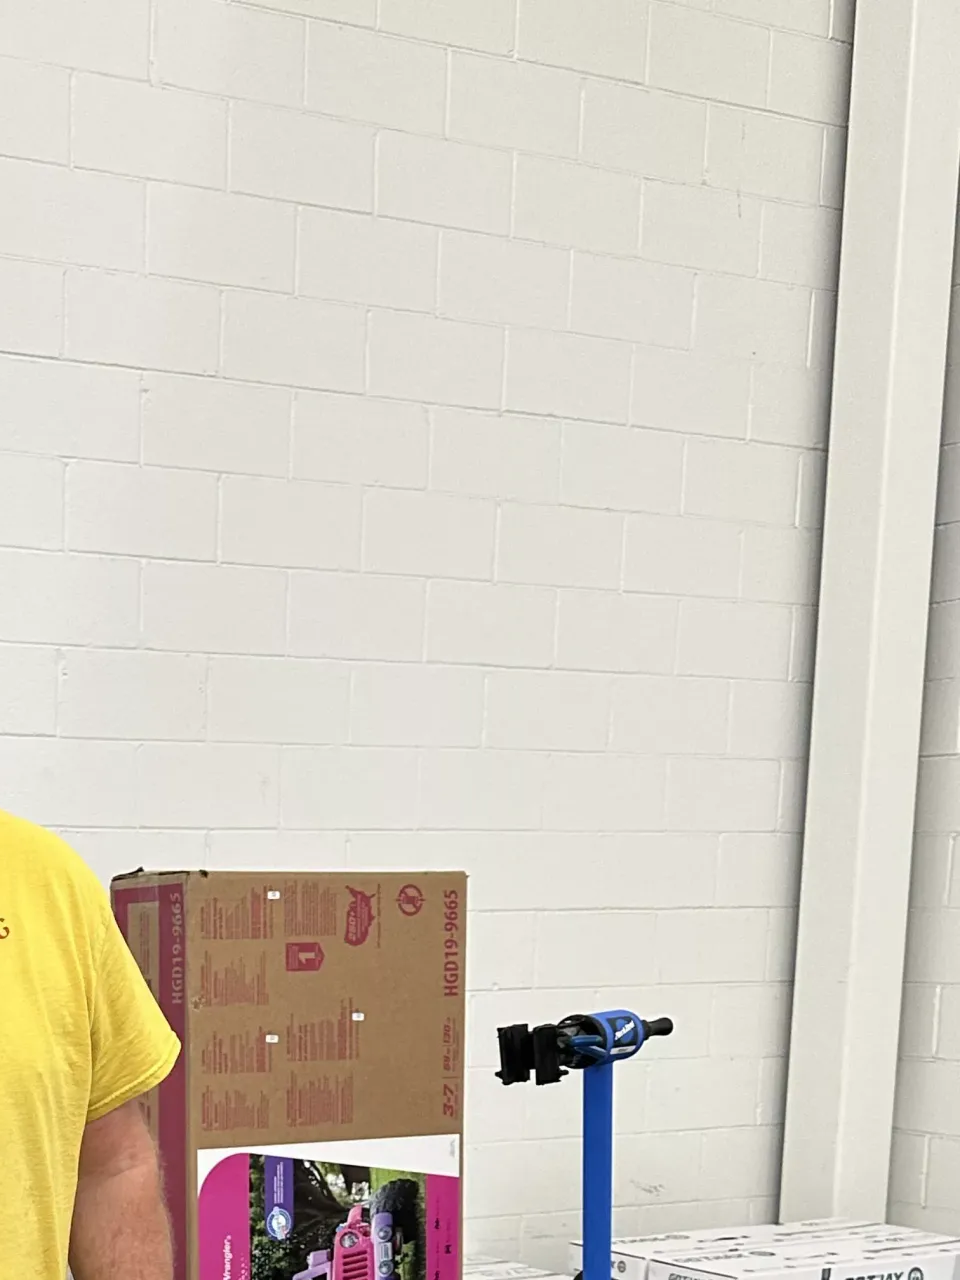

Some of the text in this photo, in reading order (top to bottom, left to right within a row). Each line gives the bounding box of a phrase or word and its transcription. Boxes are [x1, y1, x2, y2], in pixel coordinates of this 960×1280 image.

[170, 892, 182, 1004] HGD19-9665
[443, 889, 459, 997] HGD19-9665
[443, 1082, 454, 1118] 3-7
